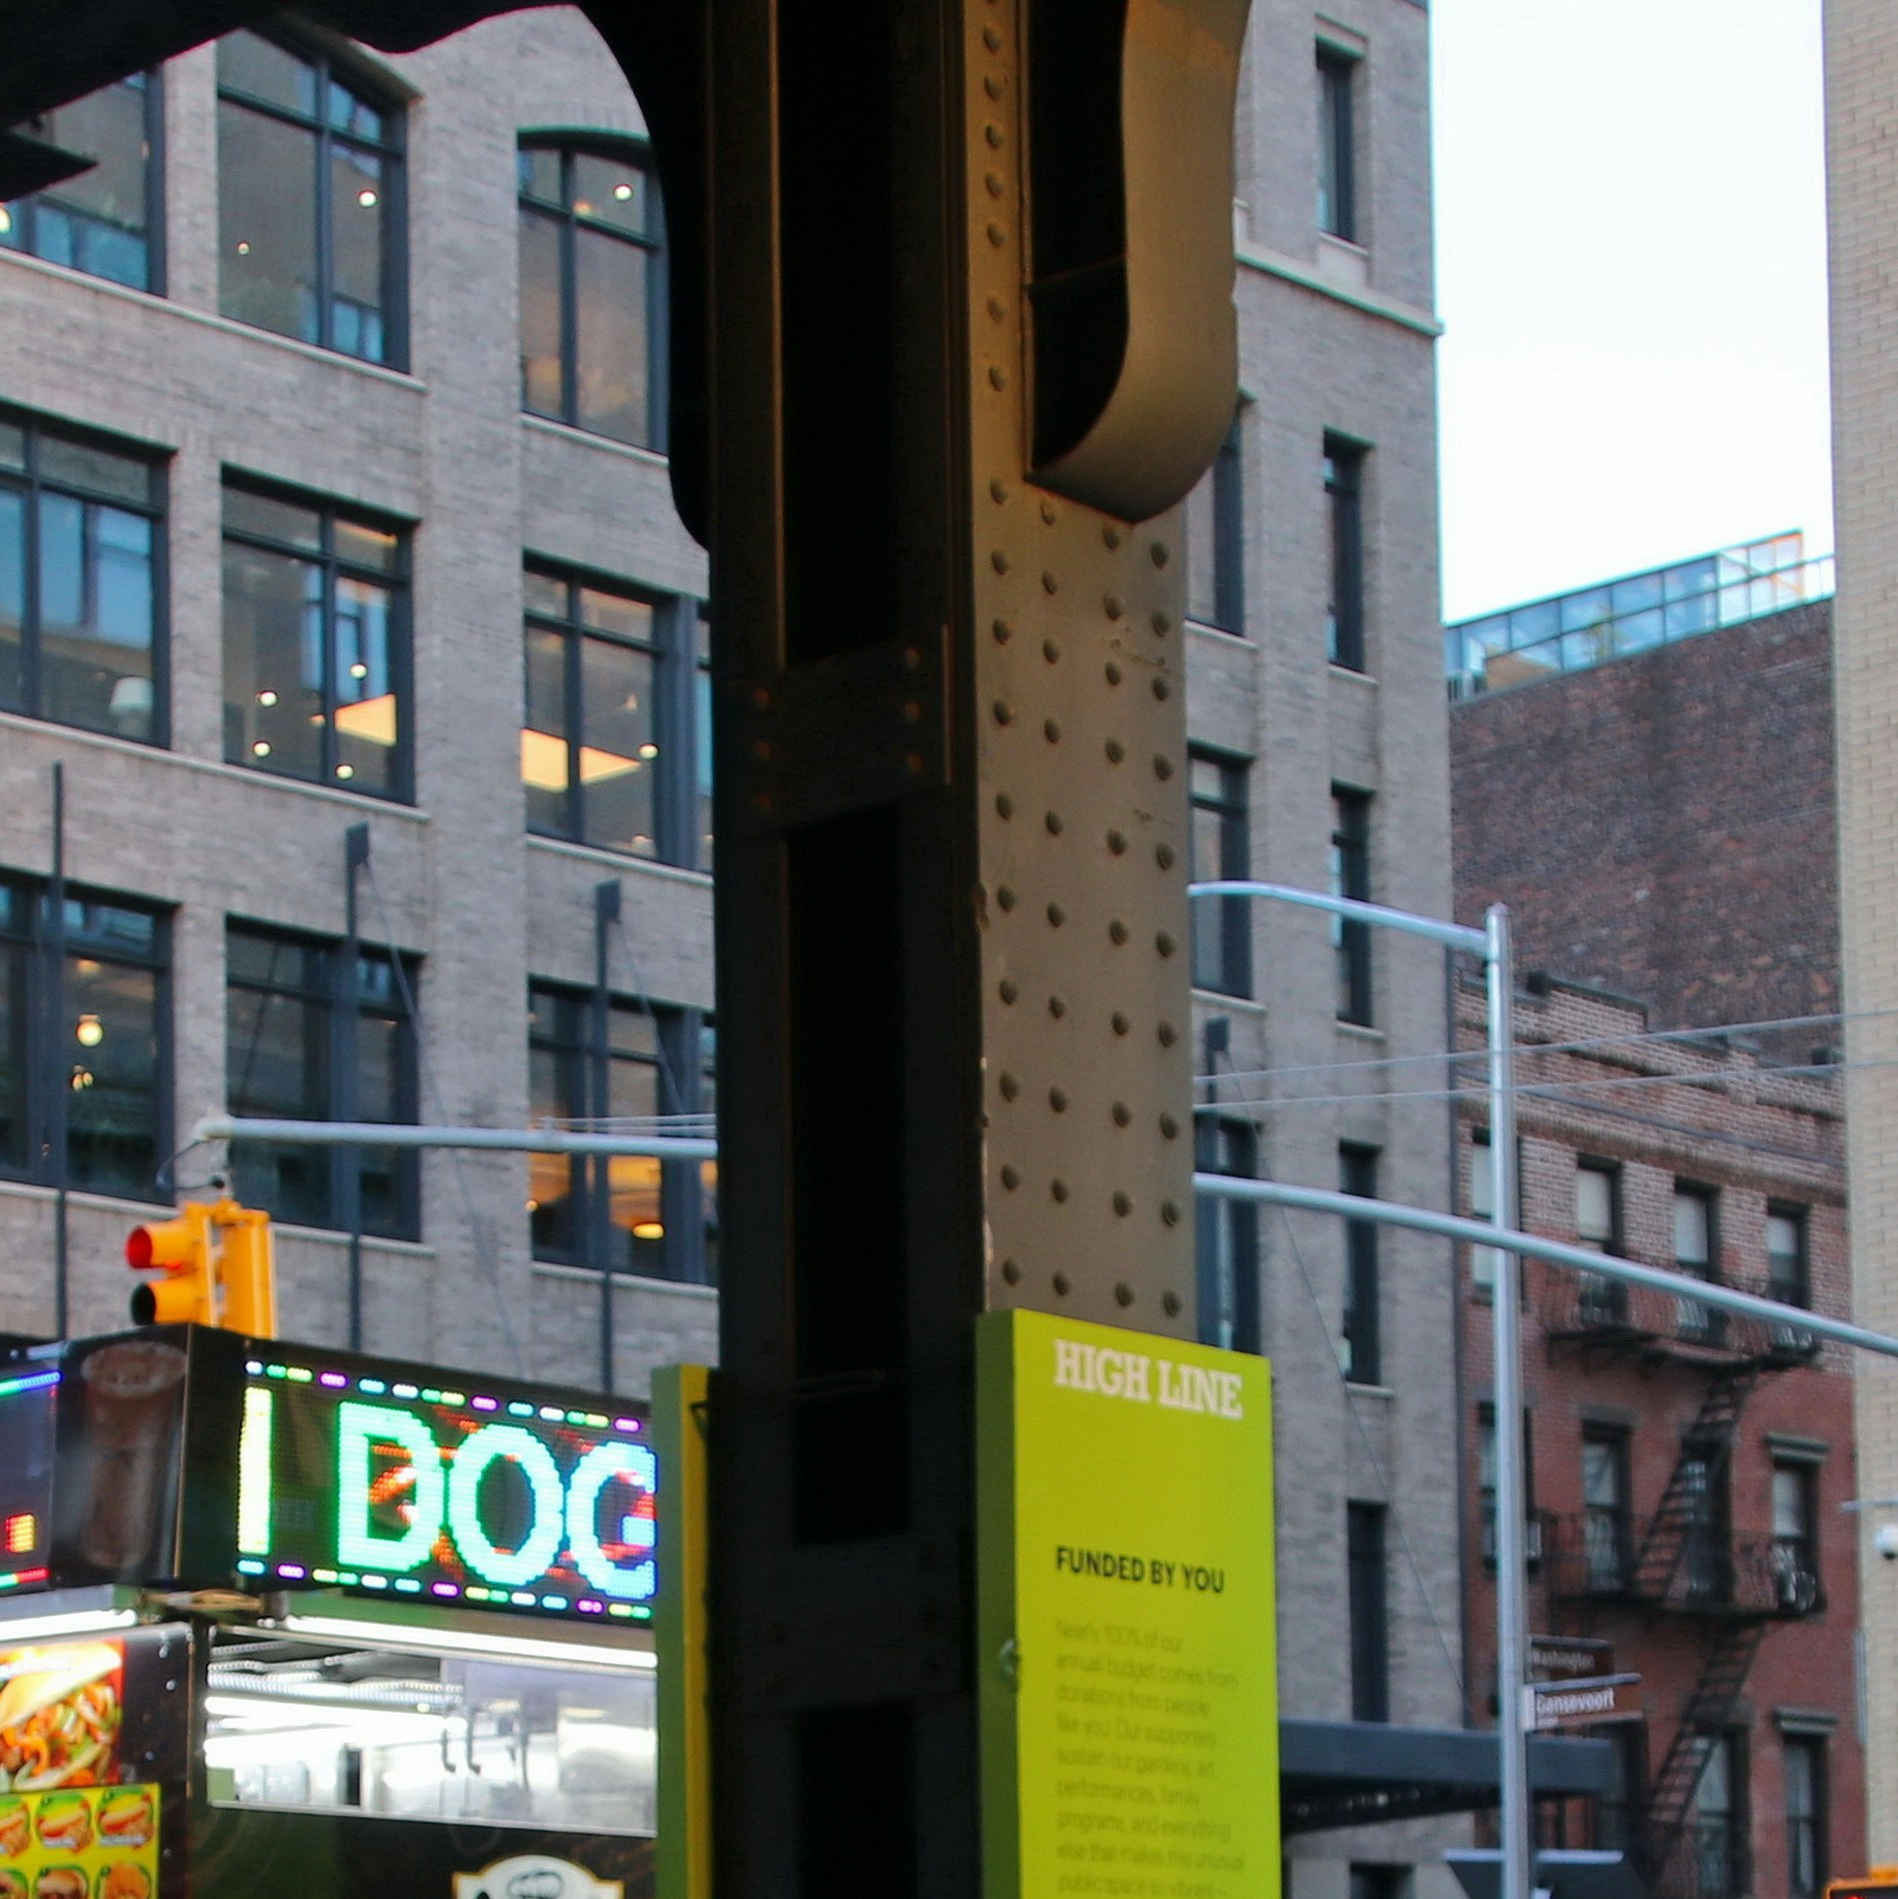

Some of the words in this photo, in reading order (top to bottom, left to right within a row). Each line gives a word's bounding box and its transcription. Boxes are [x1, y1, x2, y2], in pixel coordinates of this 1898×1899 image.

[1054, 1338, 1150, 1402] HIGH
[1158, 1359, 1243, 1421] LINE
[1055, 1545, 1145, 1584] FUNDED
[1151, 1557, 1176, 1587] BY
[1183, 1562, 1226, 1593] YOU
